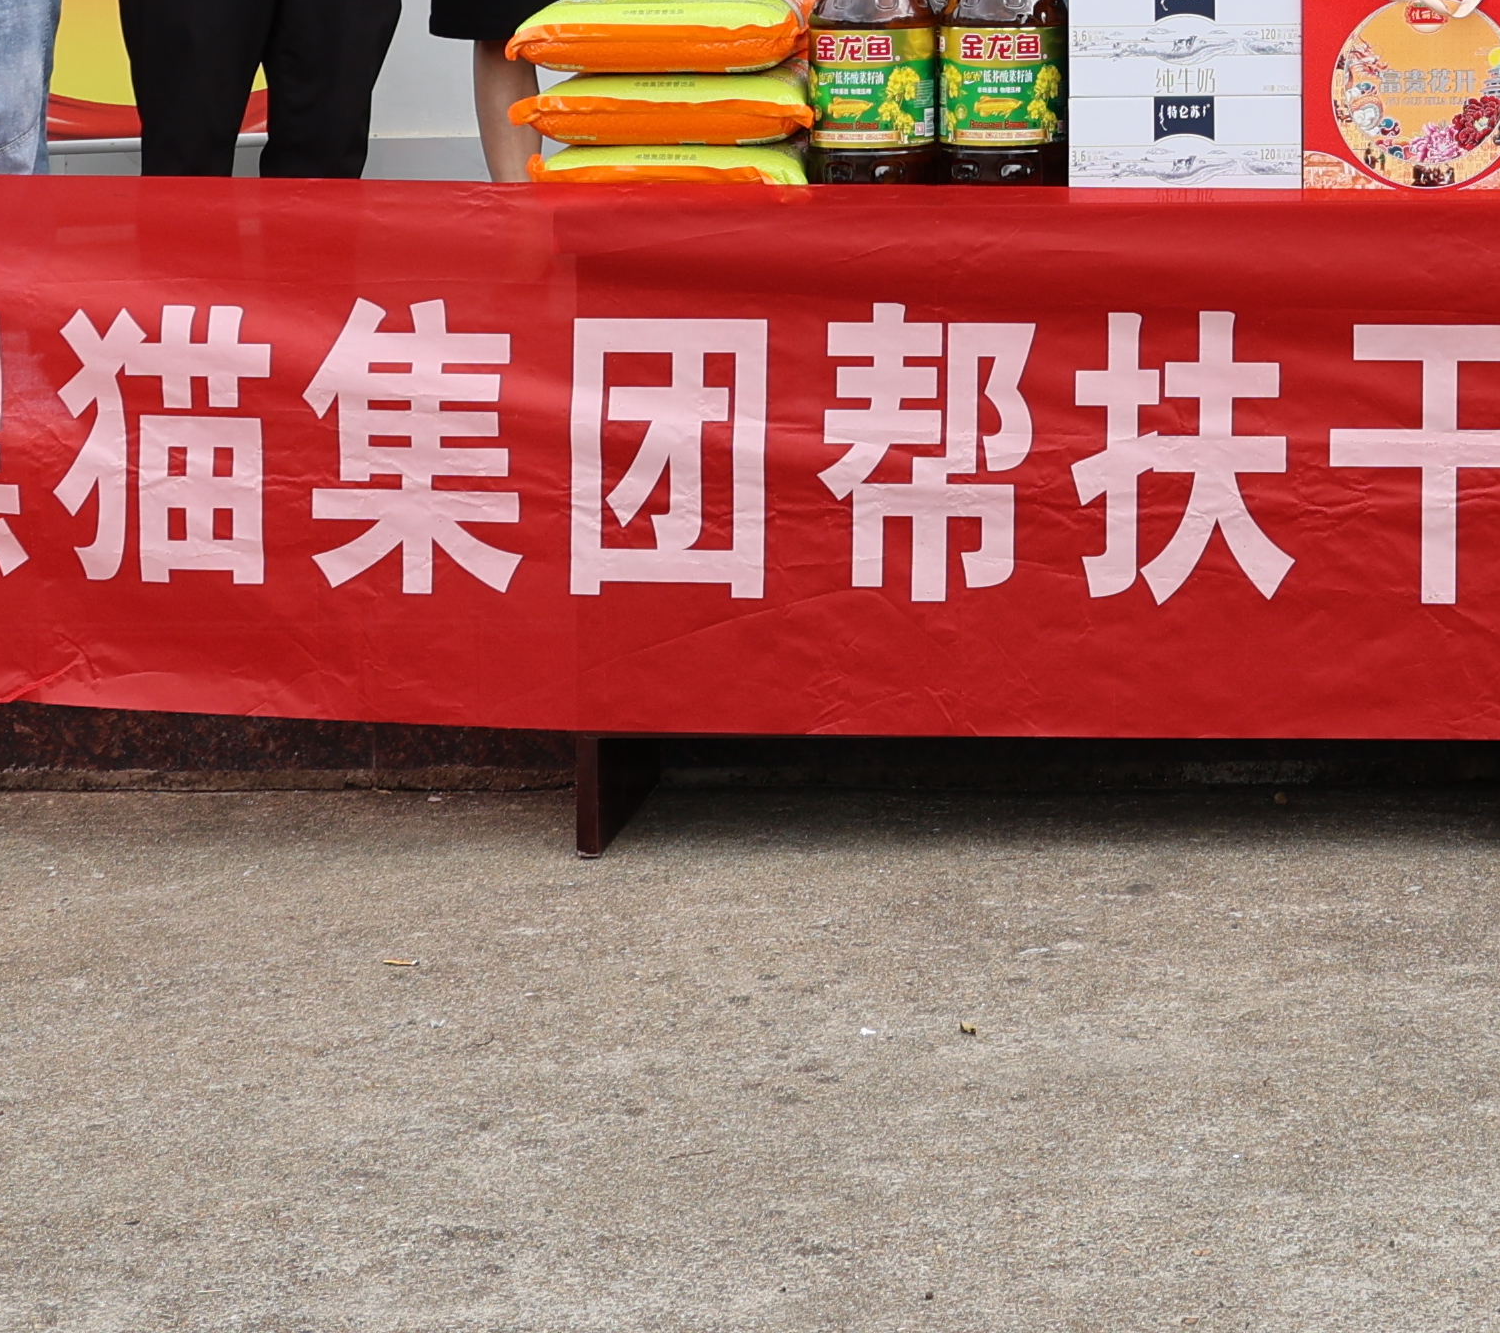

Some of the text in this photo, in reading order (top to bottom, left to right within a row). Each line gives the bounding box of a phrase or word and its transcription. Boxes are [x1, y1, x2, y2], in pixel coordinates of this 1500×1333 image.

[1261, 28, 1276, 40] 120
[816, 35, 893, 62] 金龙鱼
[960, 34, 1041, 61] 金龙鱼
[1155, 68, 1216, 94] 纯牛奶
[1379, 69, 1477, 94] 富贵花开
[1166, 104, 1201, 120] 特仑苏
[1260, 148, 1276, 161] 120
